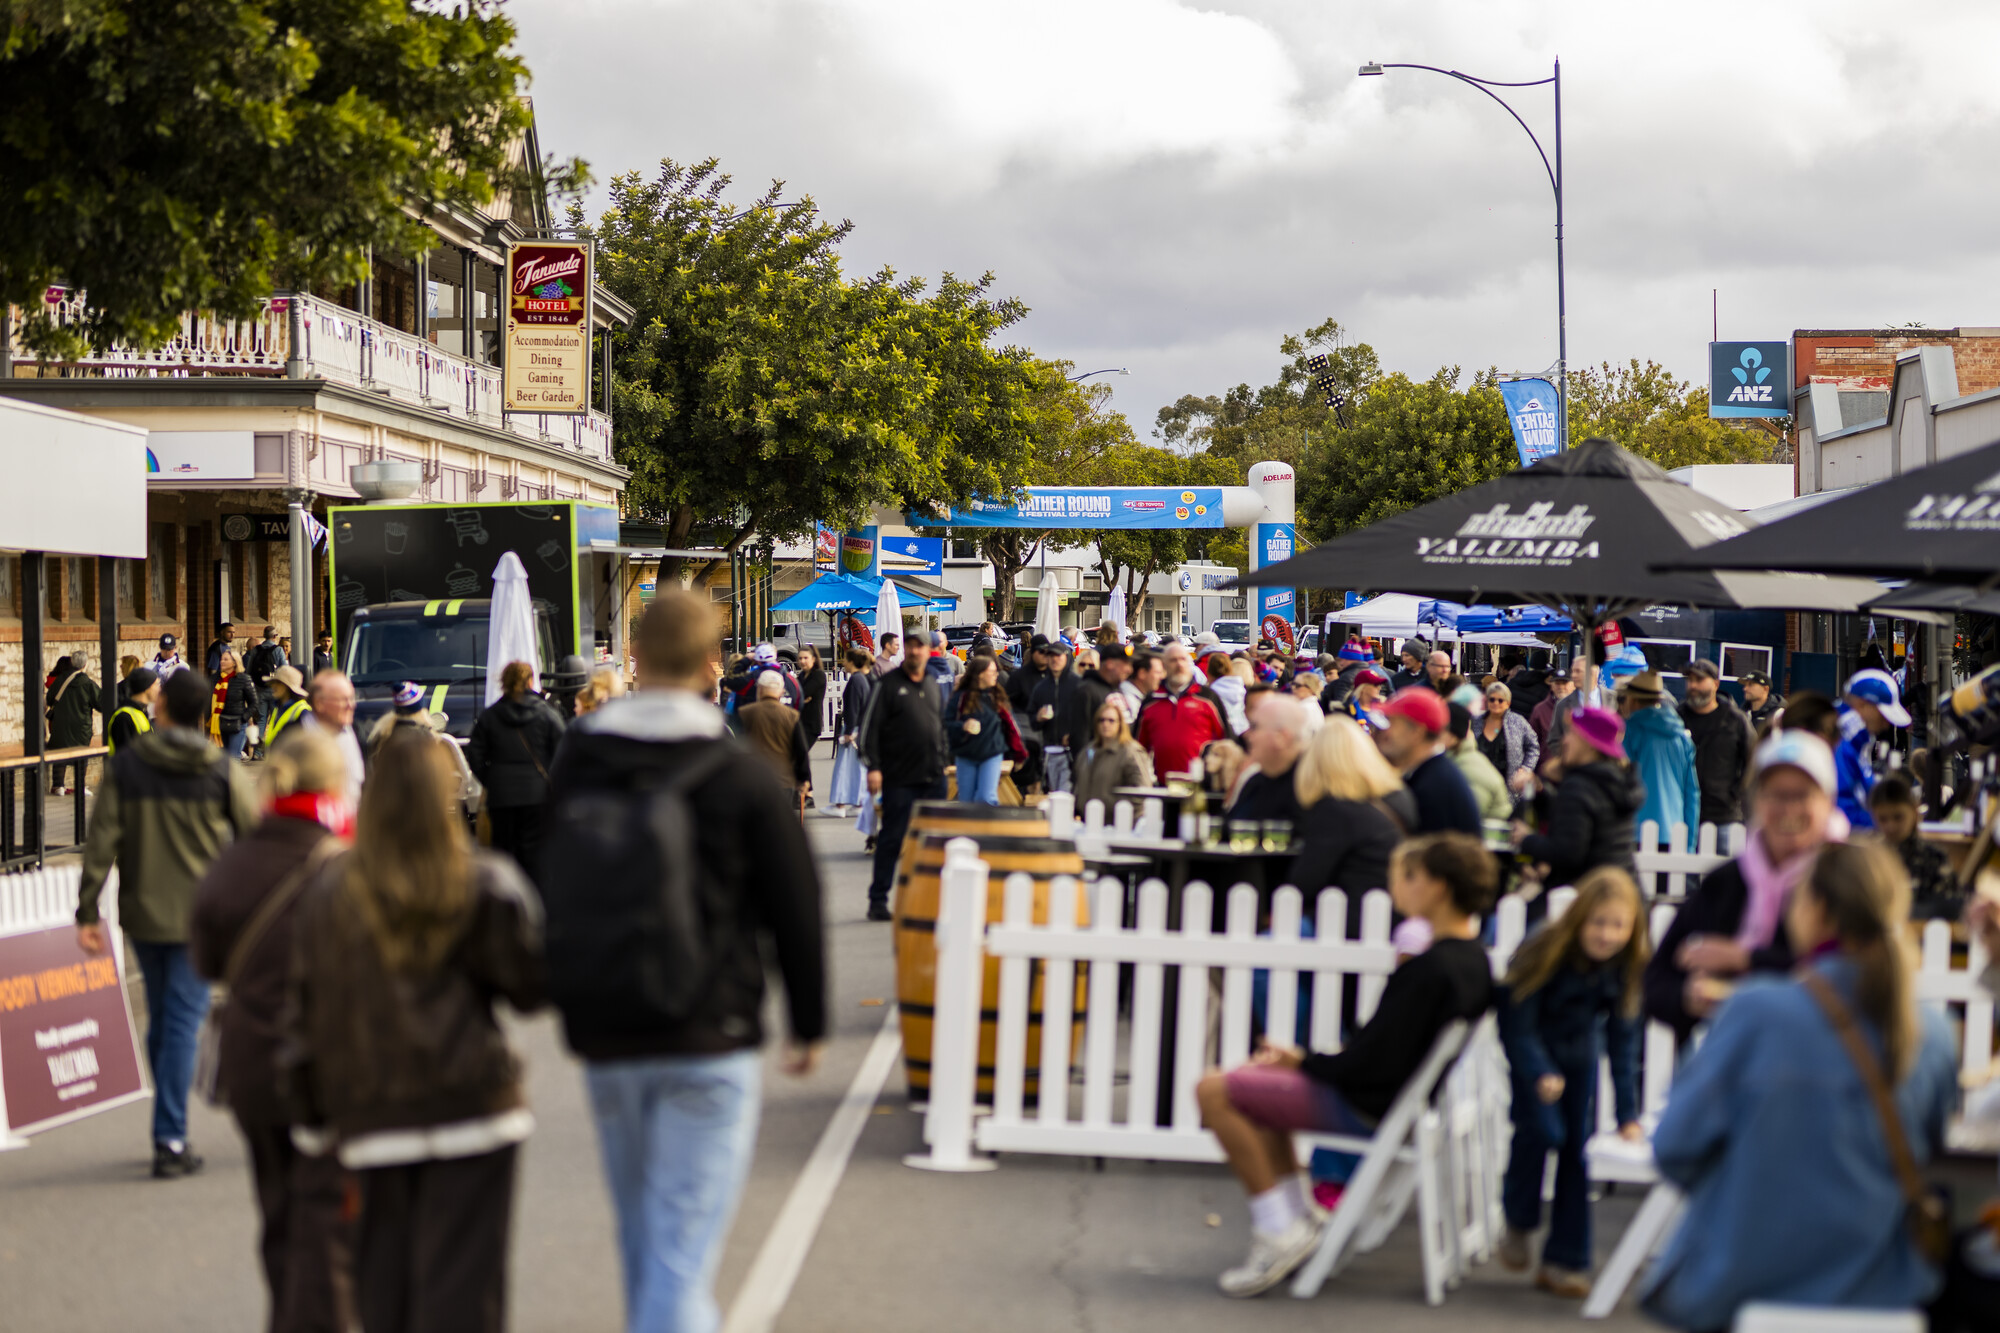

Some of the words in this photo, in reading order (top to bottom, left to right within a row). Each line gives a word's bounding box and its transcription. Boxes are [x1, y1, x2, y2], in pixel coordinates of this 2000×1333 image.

[514, 254, 581, 295] Tanunda
[528, 301, 568, 311] HOTEL
[548, 315, 569, 323] 1846
[514, 335, 579, 347] Accommodation
[530, 353, 562, 367] Dining
[528, 372, 564, 386] Gaming
[516, 390, 537, 402] Beer
[542, 391, 574, 403] Garden
[1727, 386, 1773, 402] ANZ
[1263, 473, 1292, 482] ADELAIDE
[1067, 496, 1111, 512] ROUND
[261, 522, 290, 535] TAV
[1266, 539, 1292, 550] GATHER
[1417, 537, 1600, 559] YALUMBA
[815, 600, 851, 609] HAHN
